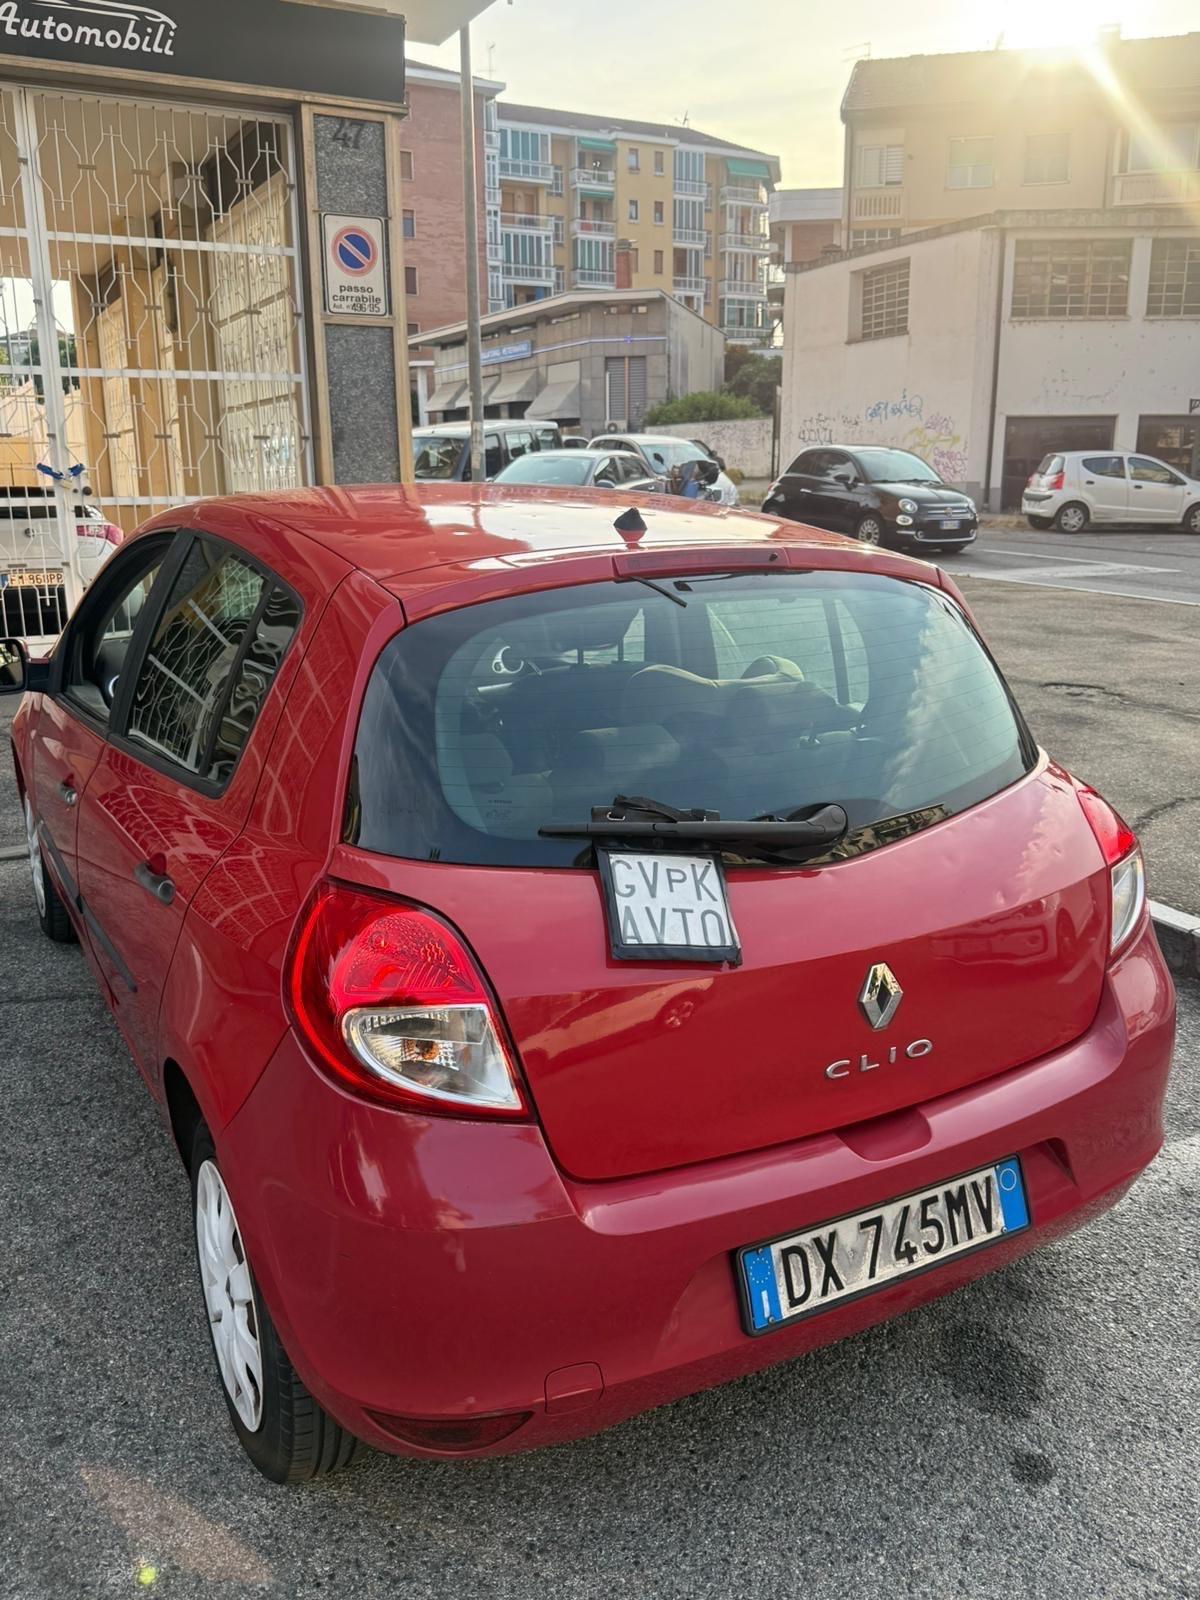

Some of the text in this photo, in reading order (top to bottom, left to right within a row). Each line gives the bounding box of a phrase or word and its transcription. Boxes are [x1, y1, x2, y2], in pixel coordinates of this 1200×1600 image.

[0, 1, 175, 56] Automobili
[332, 294, 382, 304] carrabile
[339, 285, 374, 293] passo
[622, 905, 727, 946] AVTO
[825, 1039, 933, 1079] CLIO
[780, 1230, 845, 1308] DX
[859, 1175, 994, 1280] 745MV
